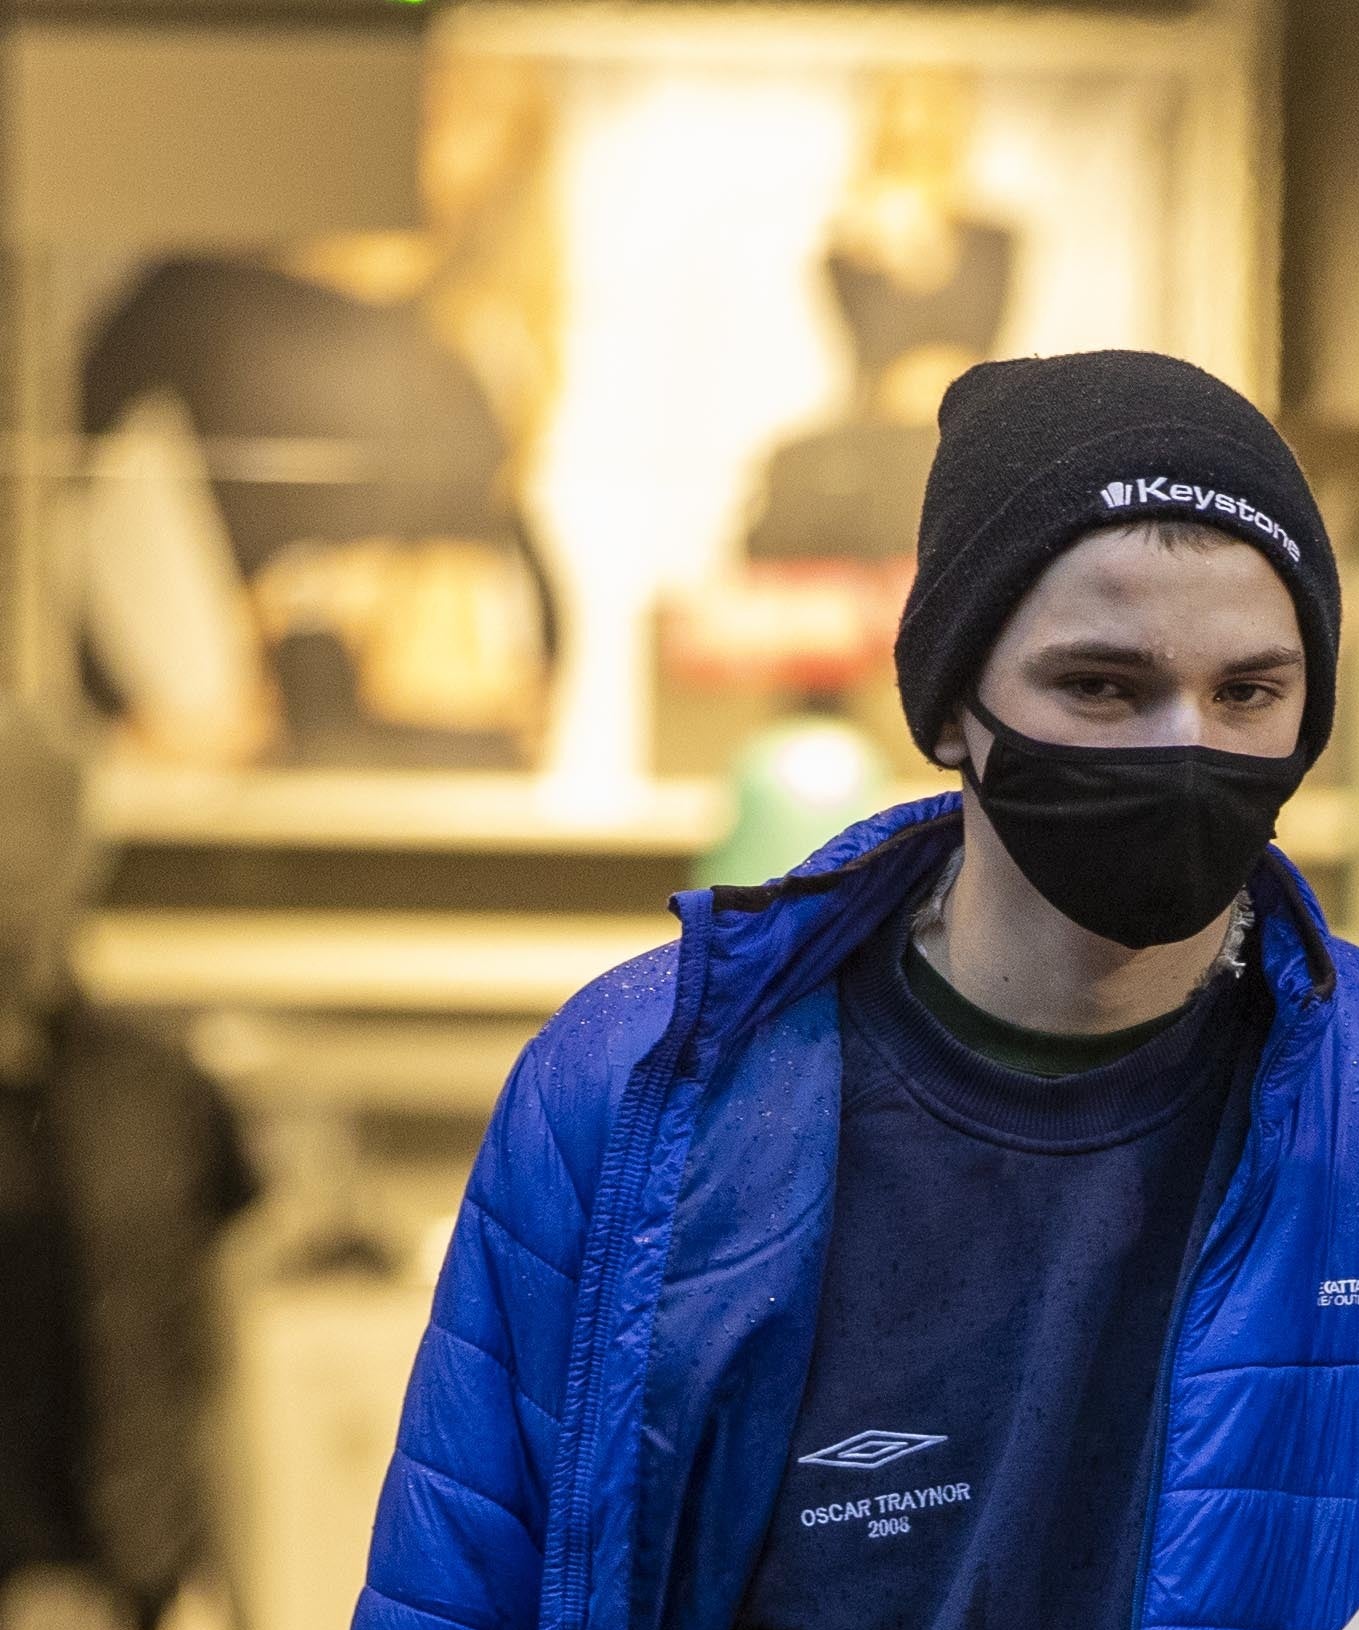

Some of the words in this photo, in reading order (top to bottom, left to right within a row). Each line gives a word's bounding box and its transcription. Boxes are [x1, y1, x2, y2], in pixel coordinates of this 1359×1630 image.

[1136, 476, 1302, 562] Keystone
[800, 1498, 872, 1527] OSCAR
[874, 1482, 972, 1514] TRAYNOR
